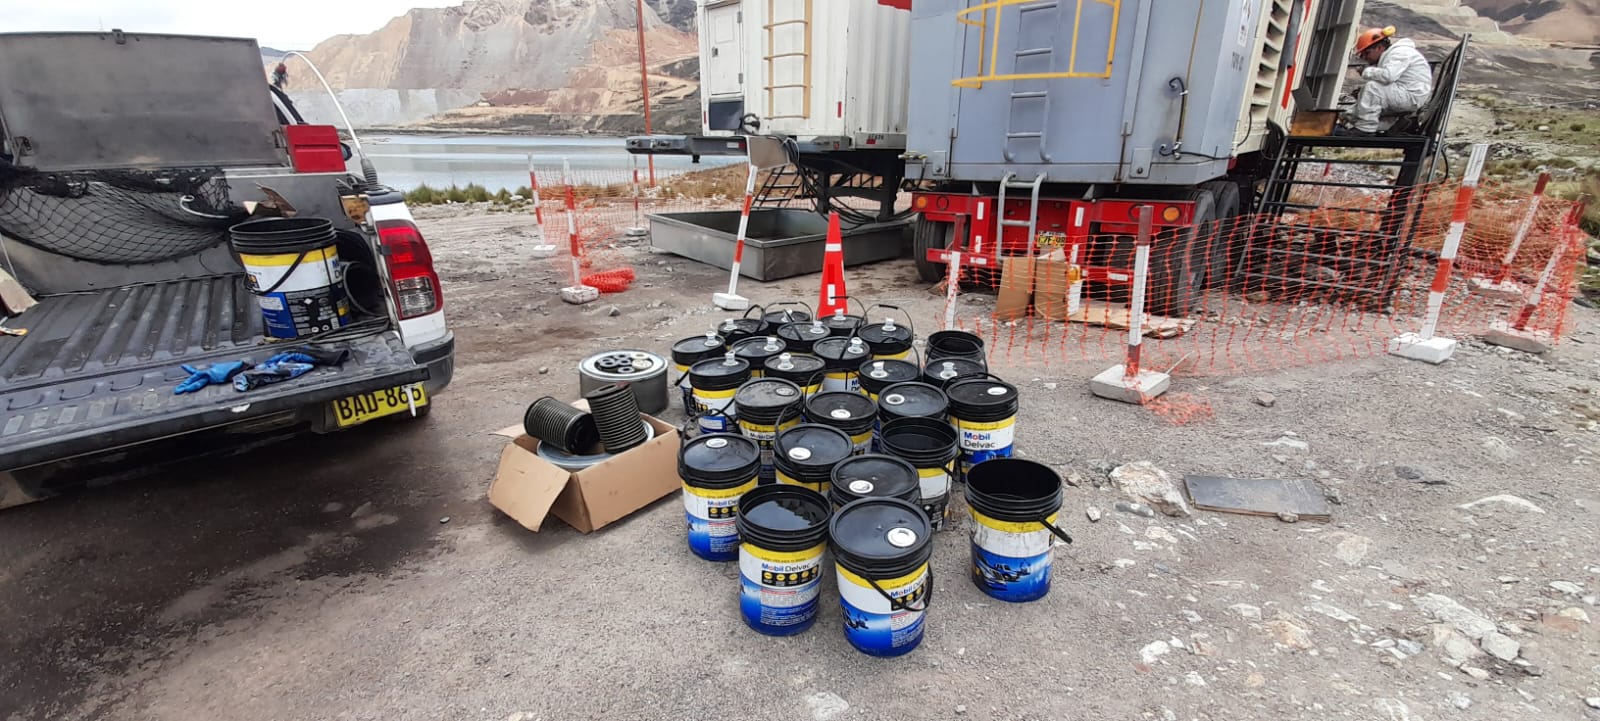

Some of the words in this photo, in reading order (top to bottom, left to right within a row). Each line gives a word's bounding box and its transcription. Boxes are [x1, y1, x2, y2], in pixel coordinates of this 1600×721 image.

[964, 431, 990, 440] Mobil
[964, 440, 995, 448] Delvac
[761, 562, 785, 572] Mobil
[785, 562, 811, 572] Delvac
[891, 585, 913, 598] Mobil
